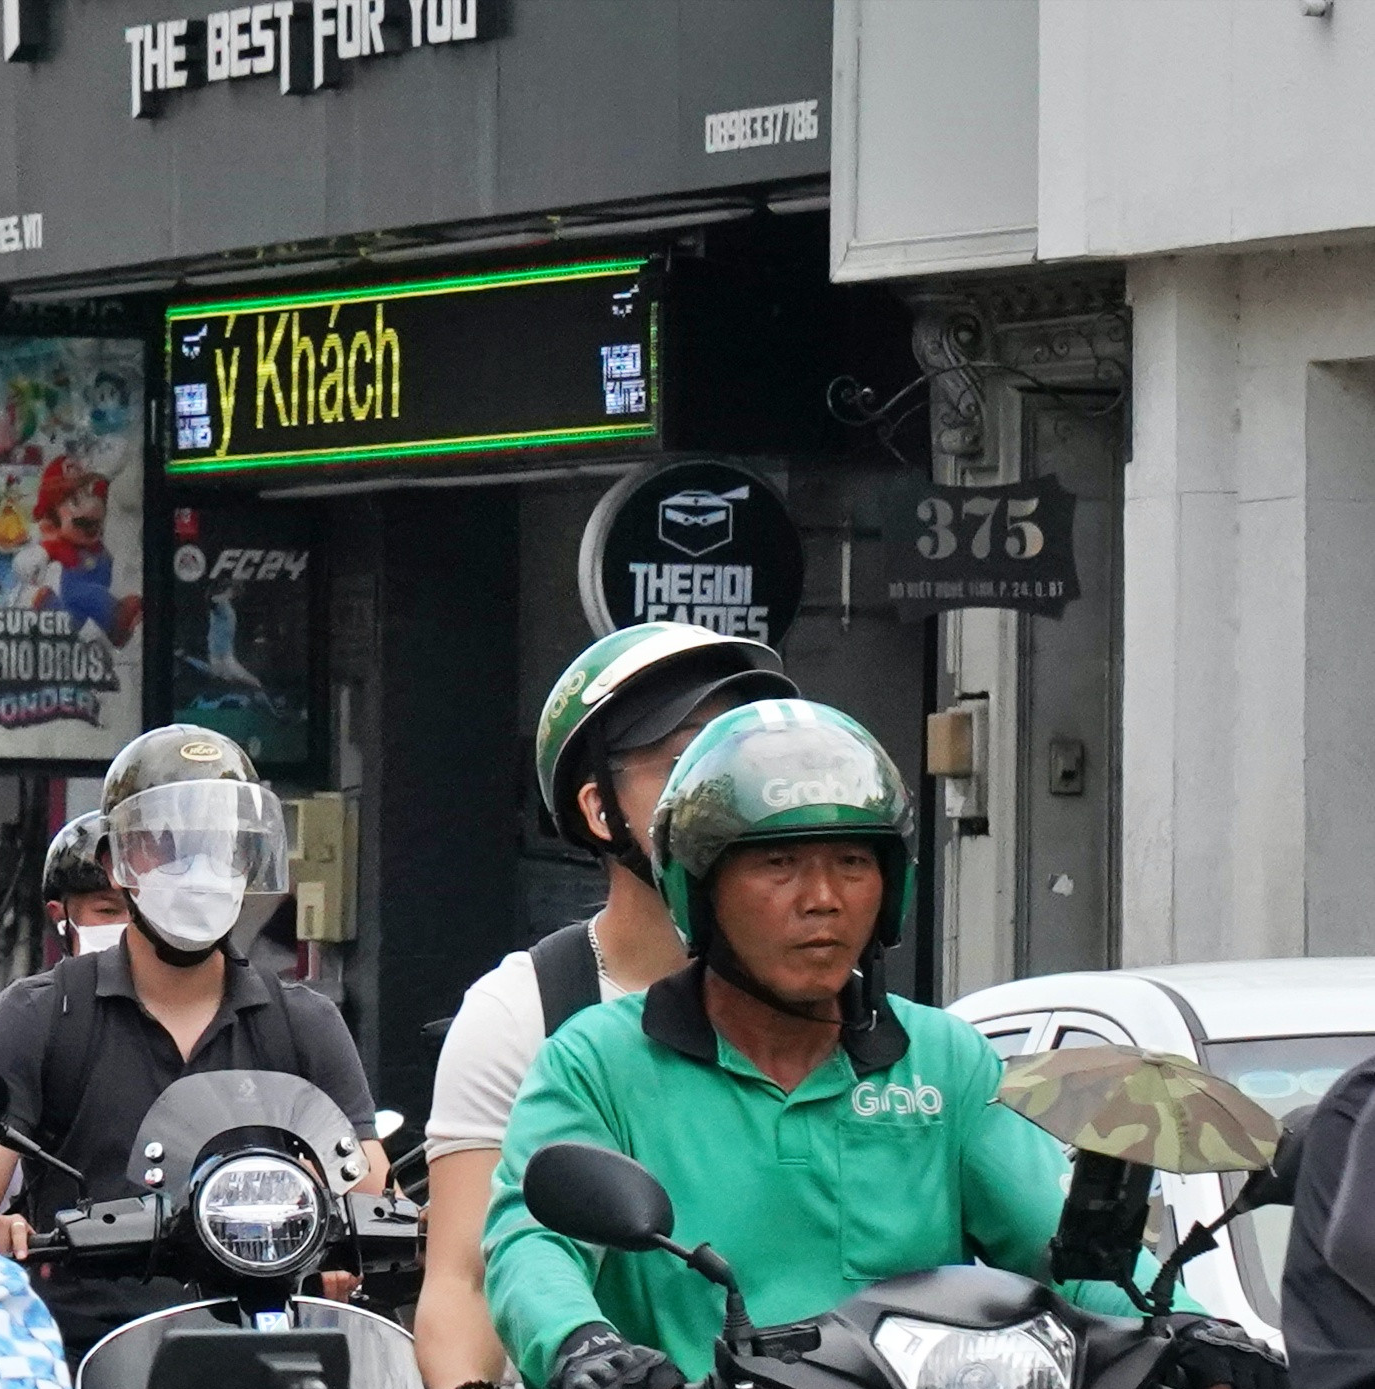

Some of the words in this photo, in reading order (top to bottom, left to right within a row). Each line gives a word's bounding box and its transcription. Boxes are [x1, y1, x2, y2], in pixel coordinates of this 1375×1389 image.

[125, 20, 188, 119] THE
[207, 1, 293, 95] BEST
[314, 0, 385, 89] FOR
[409, 0, 477, 48] YOU
[256, 303, 401, 429] Khách
[916, 496, 1045, 560] 375
[629, 562, 753, 617] THEGIOI
[761, 771, 850, 808] Grab
[852, 1074, 942, 1117] Grab
